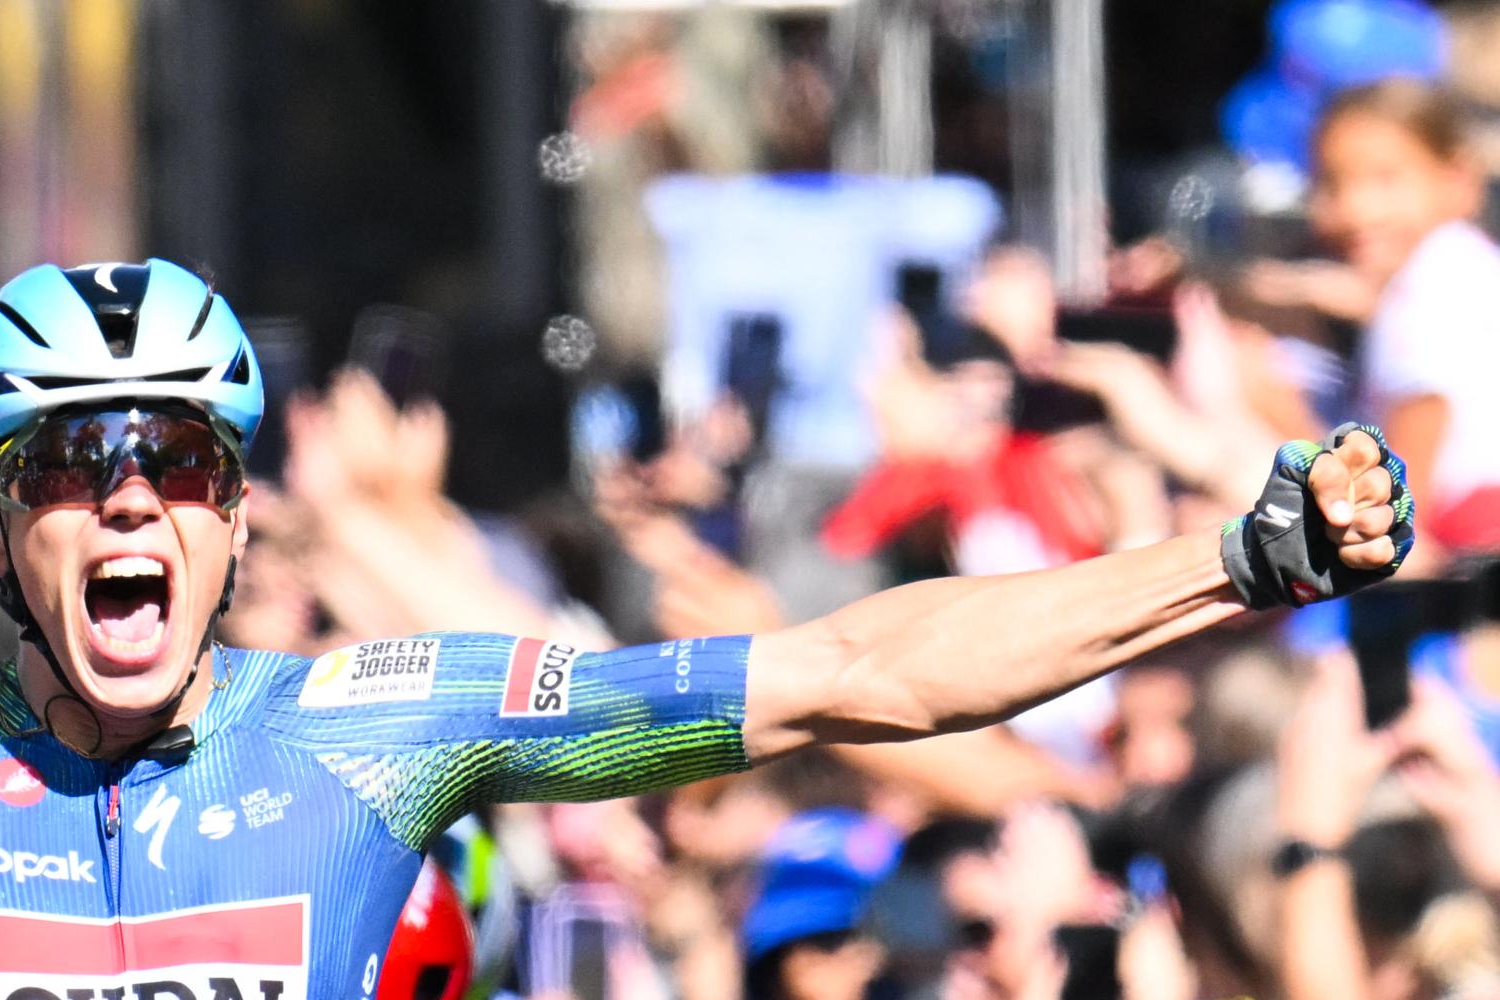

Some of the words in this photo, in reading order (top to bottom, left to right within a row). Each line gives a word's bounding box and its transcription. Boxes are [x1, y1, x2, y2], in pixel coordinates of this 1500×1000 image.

[356, 640, 435, 659] SAFETY
[351, 655, 431, 681] JOGGER
[347, 681, 426, 699] WORKWEAR
[240, 787, 269, 807] UCI
[243, 792, 293, 817] WORLD
[246, 808, 284, 829] TEAM
